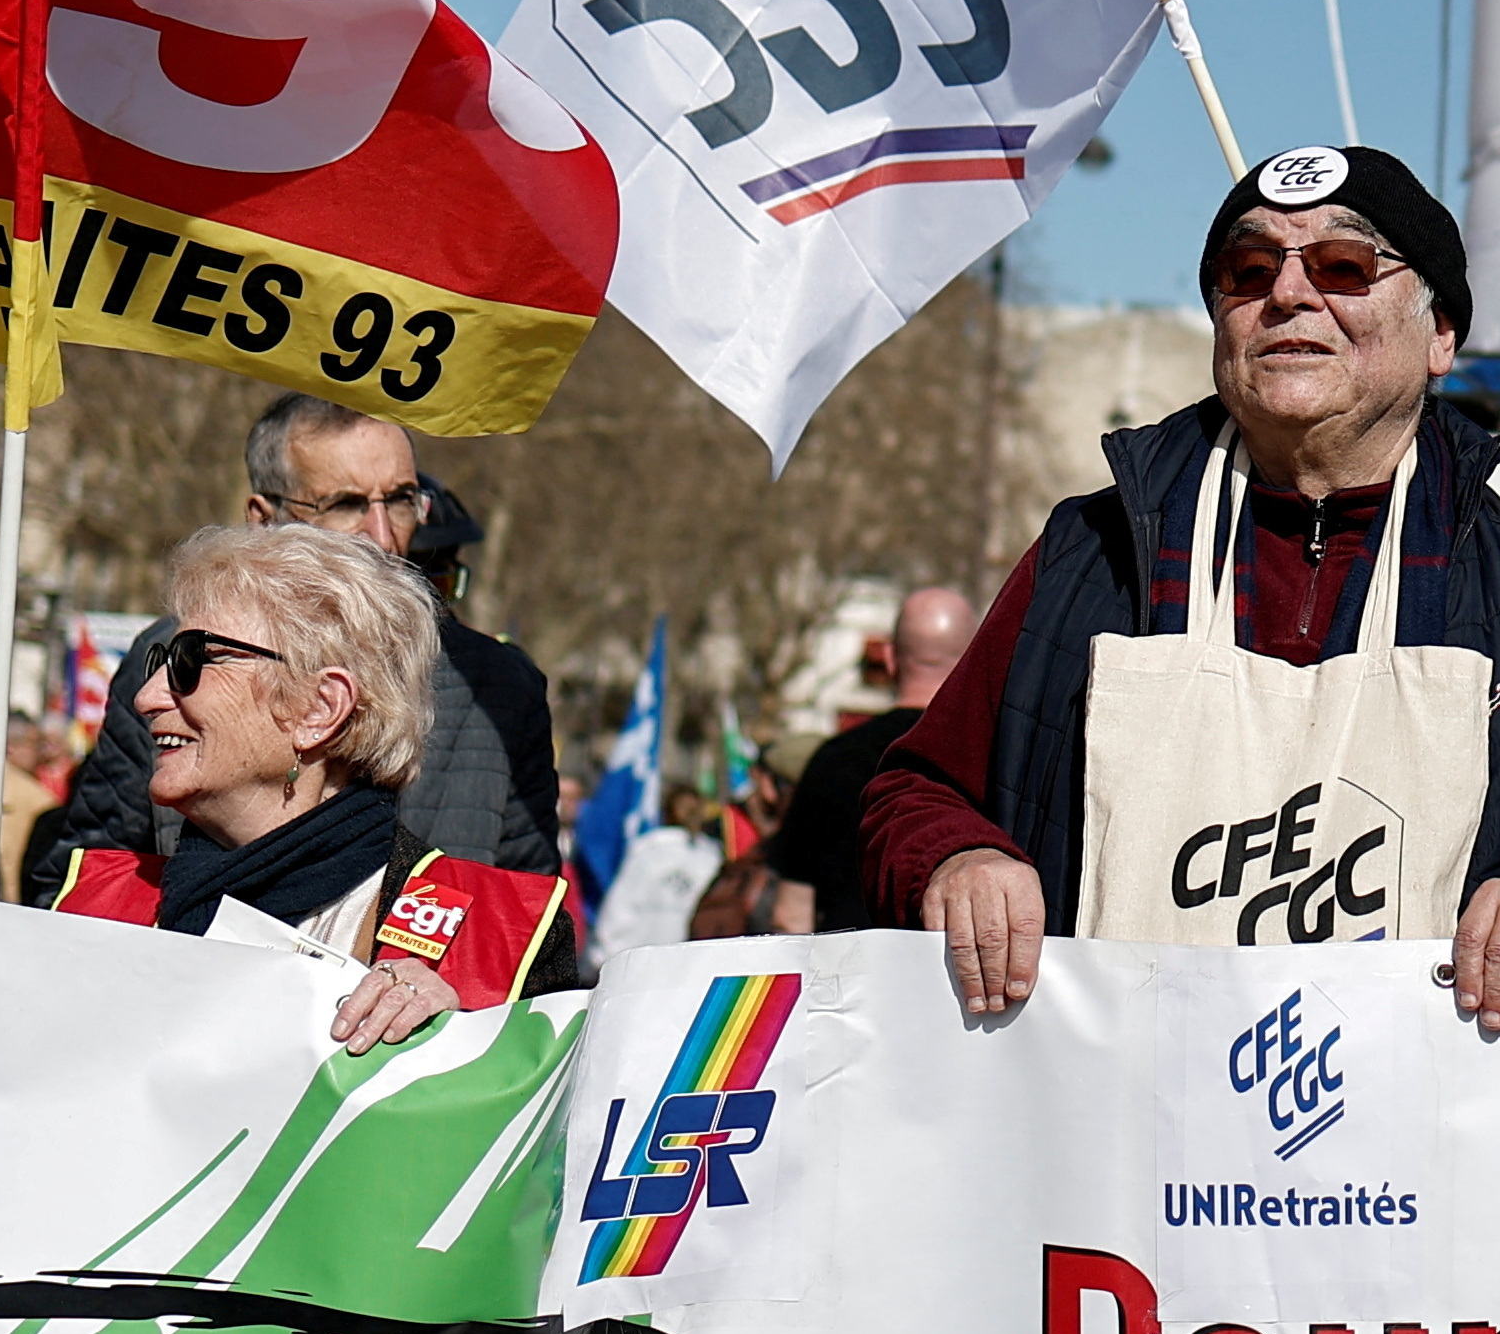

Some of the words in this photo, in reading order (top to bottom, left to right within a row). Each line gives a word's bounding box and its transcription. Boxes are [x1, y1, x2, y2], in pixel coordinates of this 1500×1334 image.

[1273, 155, 1327, 172] CFE
[1280, 169, 1334, 185] CGC
[42, 201, 304, 354] ITES
[320, 291, 456, 403] 93
[1172, 782, 1323, 909] CFE
[1237, 824, 1386, 946] CGC
[380, 929, 428, 951] RETRAITES
[430, 945, 442, 955] 93
[391, 897, 465, 937] cgt
[1229, 987, 1302, 1093] CFE
[1268, 1024, 1344, 1131] CGC
[580, 1089, 776, 1223] LSR
[1164, 1181, 1418, 1227] UNIRetraités
